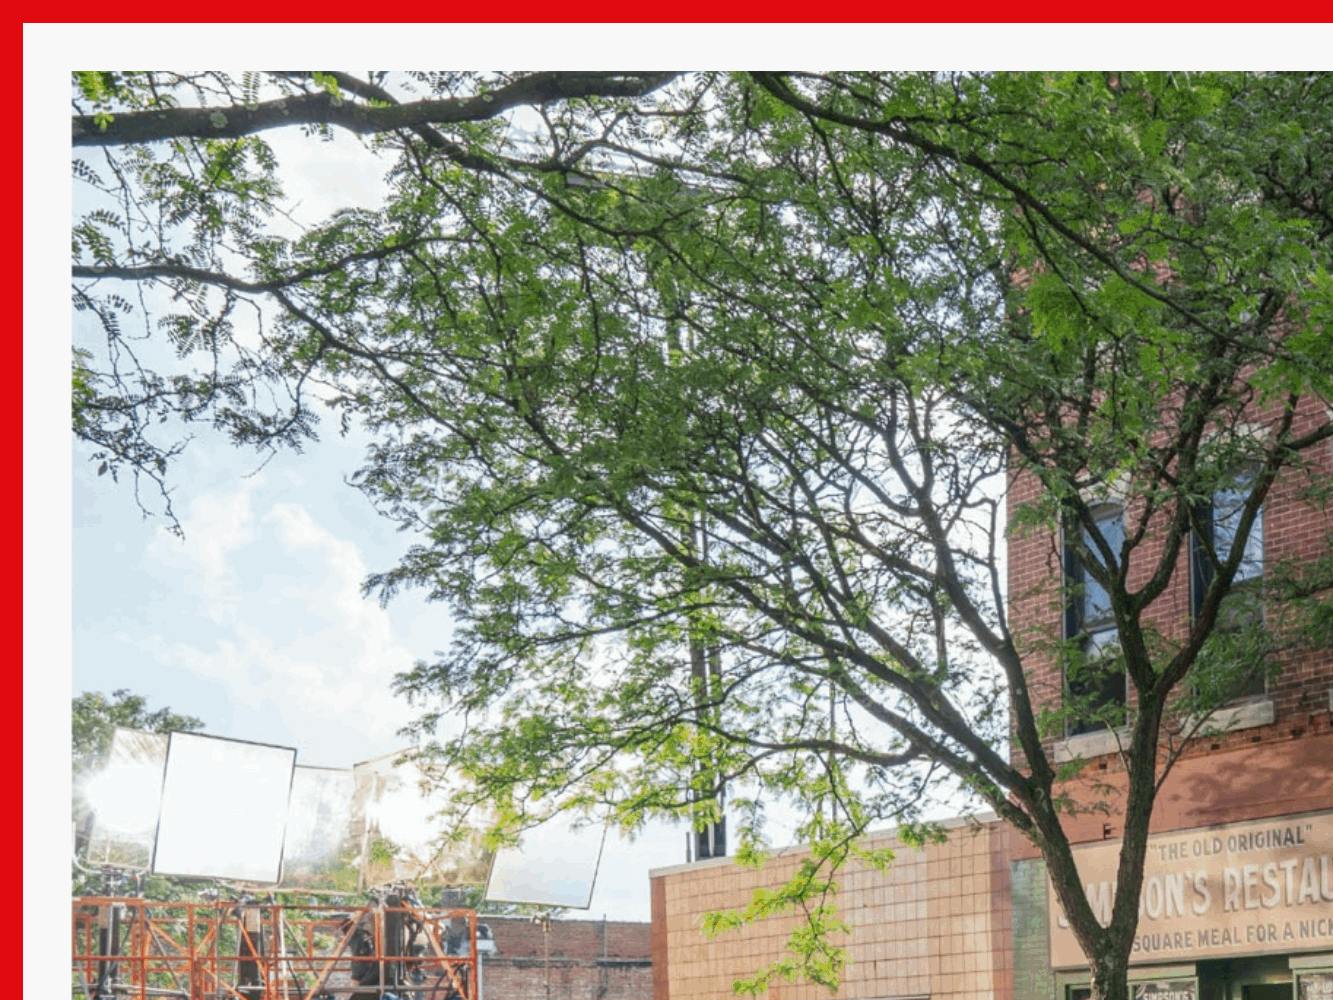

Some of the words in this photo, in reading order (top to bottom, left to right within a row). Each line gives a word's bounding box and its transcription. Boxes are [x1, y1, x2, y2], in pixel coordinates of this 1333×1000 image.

[1193, 837, 1223, 857] OLD
[1133, 930, 1193, 953] SQUARE
[1197, 927, 1241, 947] MEAL
[1246, 922, 1277, 944] FOR
[1282, 922, 1294, 940] A
